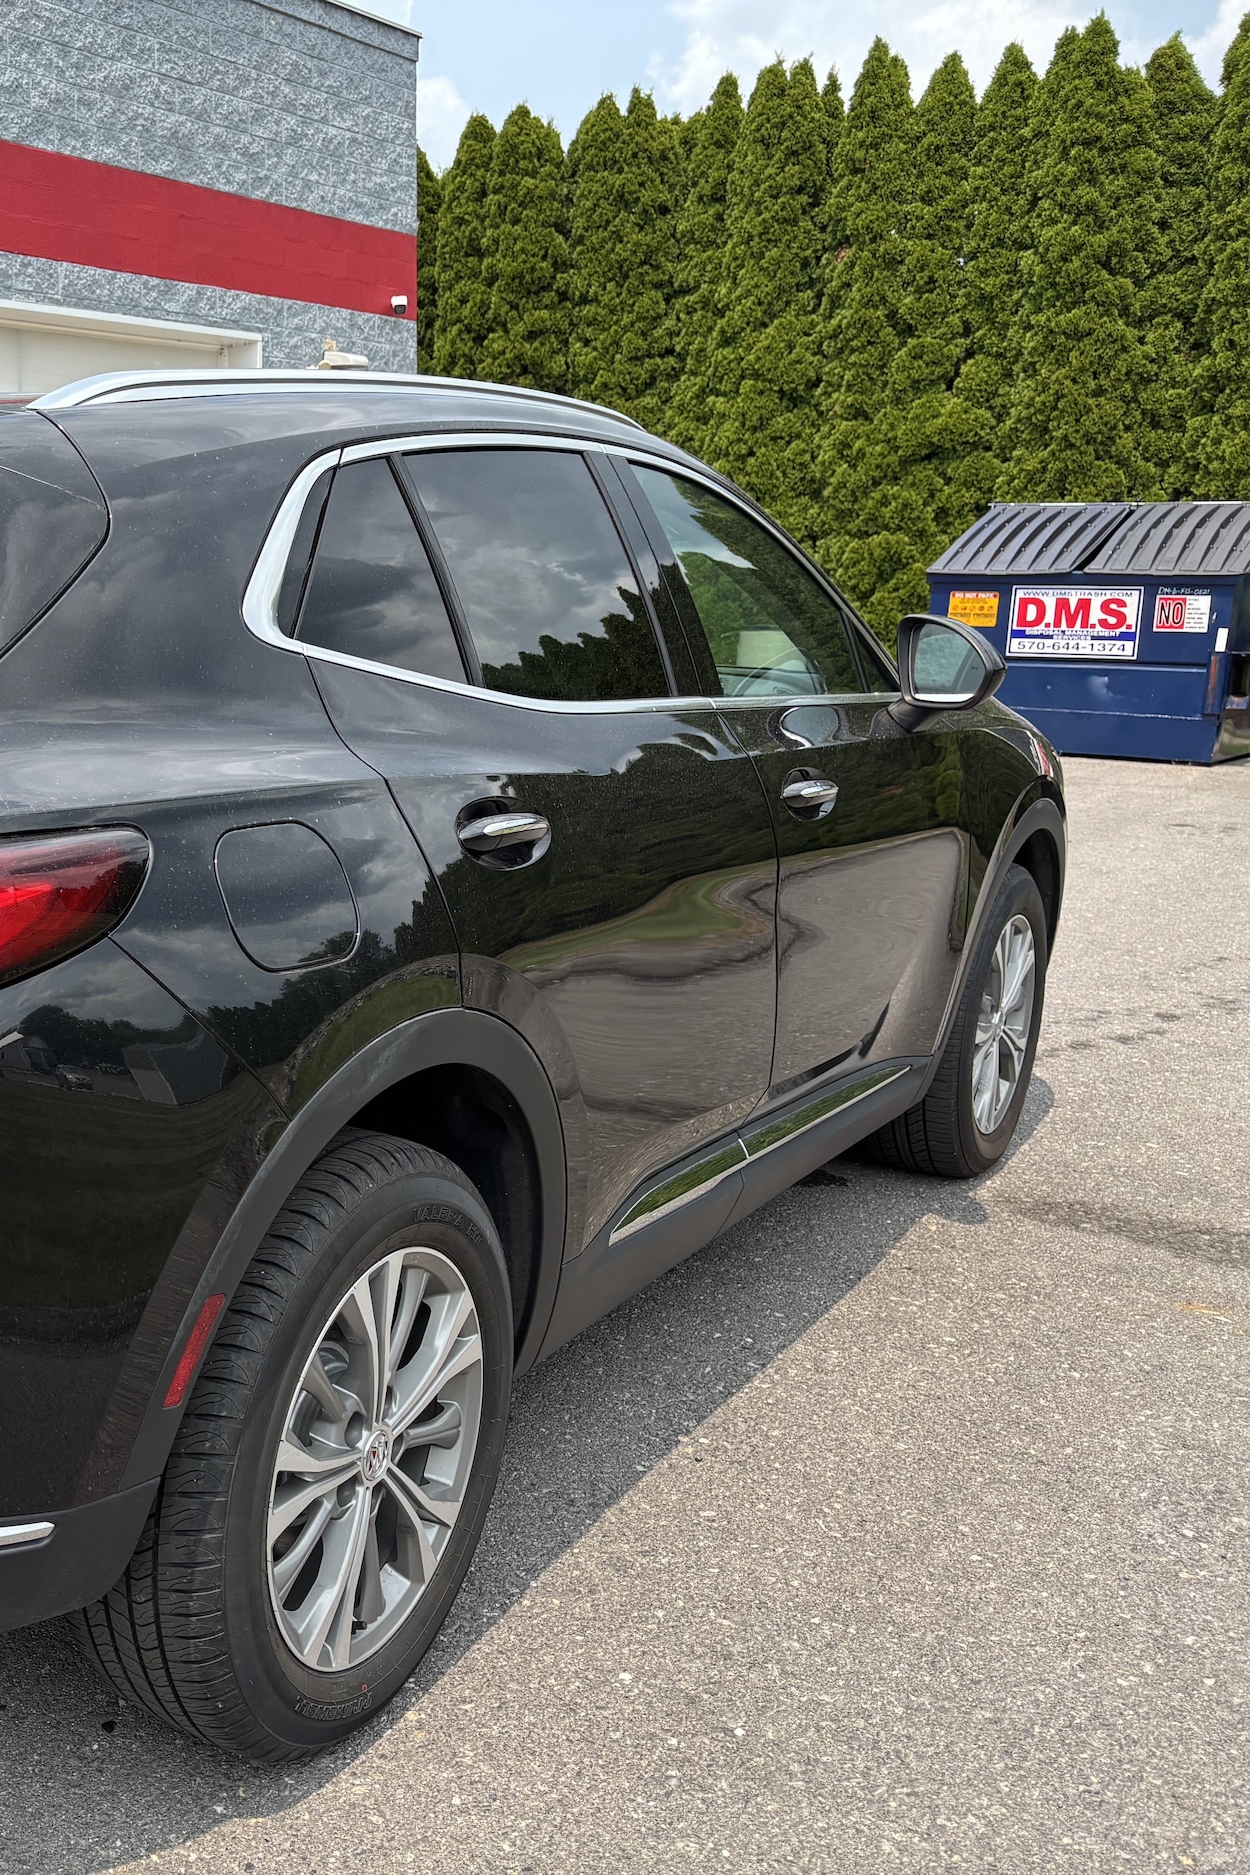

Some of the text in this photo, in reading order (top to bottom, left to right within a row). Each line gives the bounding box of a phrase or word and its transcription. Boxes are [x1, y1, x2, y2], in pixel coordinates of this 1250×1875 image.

[1016, 598, 1132, 630] D.M.S.
[1158, 600, 1184, 625] NO
[1017, 641, 1126, 652] 570-644-1374
[413, 1206, 464, 1229] VALERA
